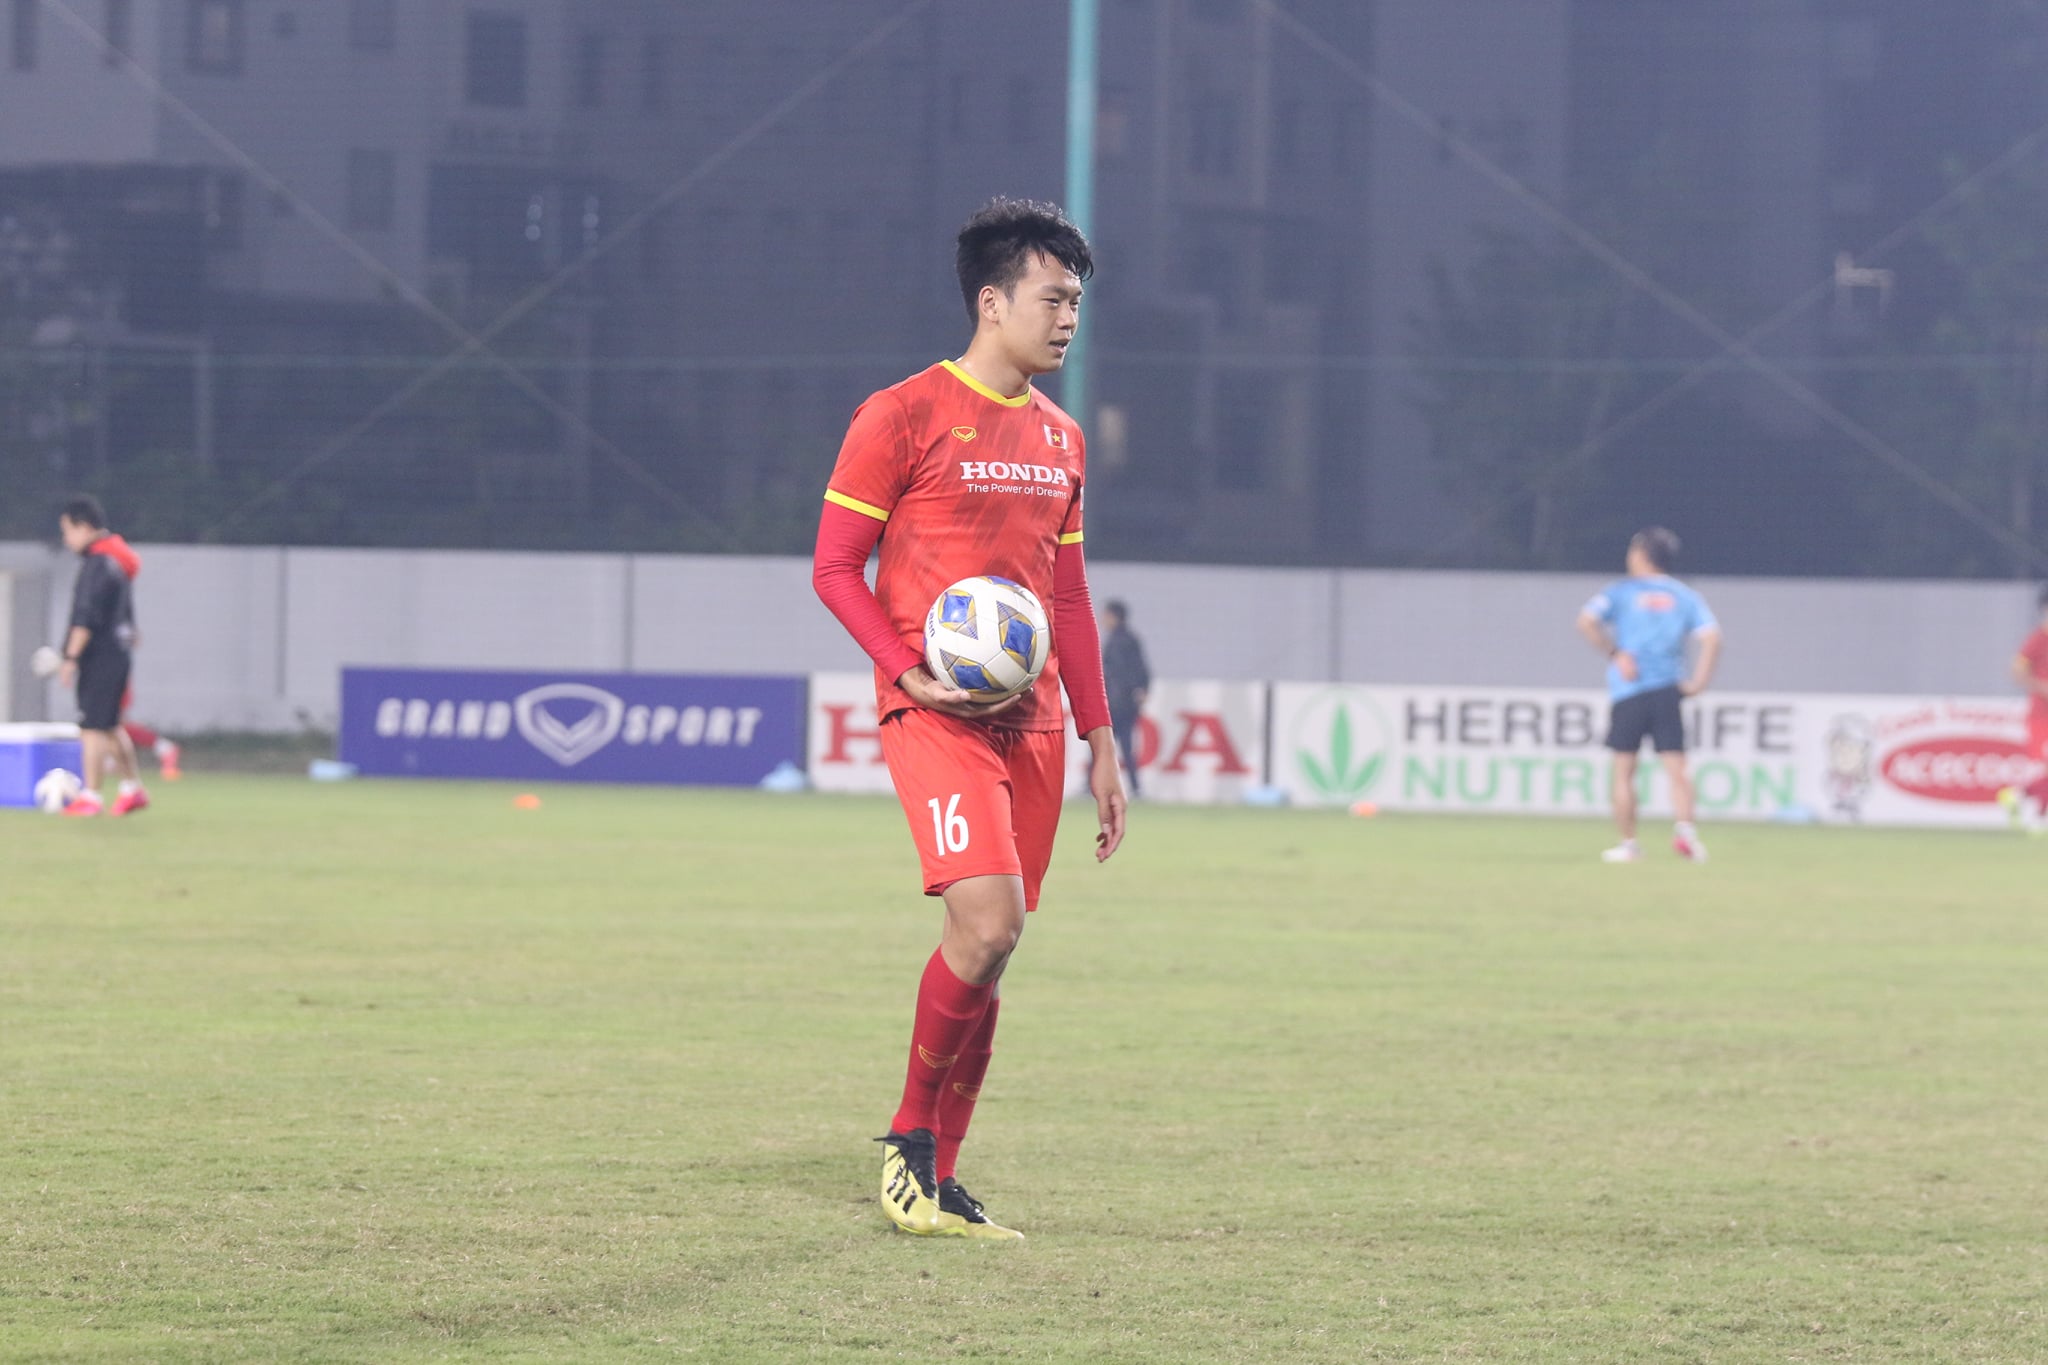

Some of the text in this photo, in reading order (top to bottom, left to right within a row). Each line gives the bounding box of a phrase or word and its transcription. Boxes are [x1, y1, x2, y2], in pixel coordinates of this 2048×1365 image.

[960, 461, 1069, 487] HONDA
[966, 483, 1068, 500] The Power of Dreams
[375, 697, 763, 746] GRAND SPORT
[1405, 698, 1795, 753] HERBIFE
[928, 793, 969, 856] 16
